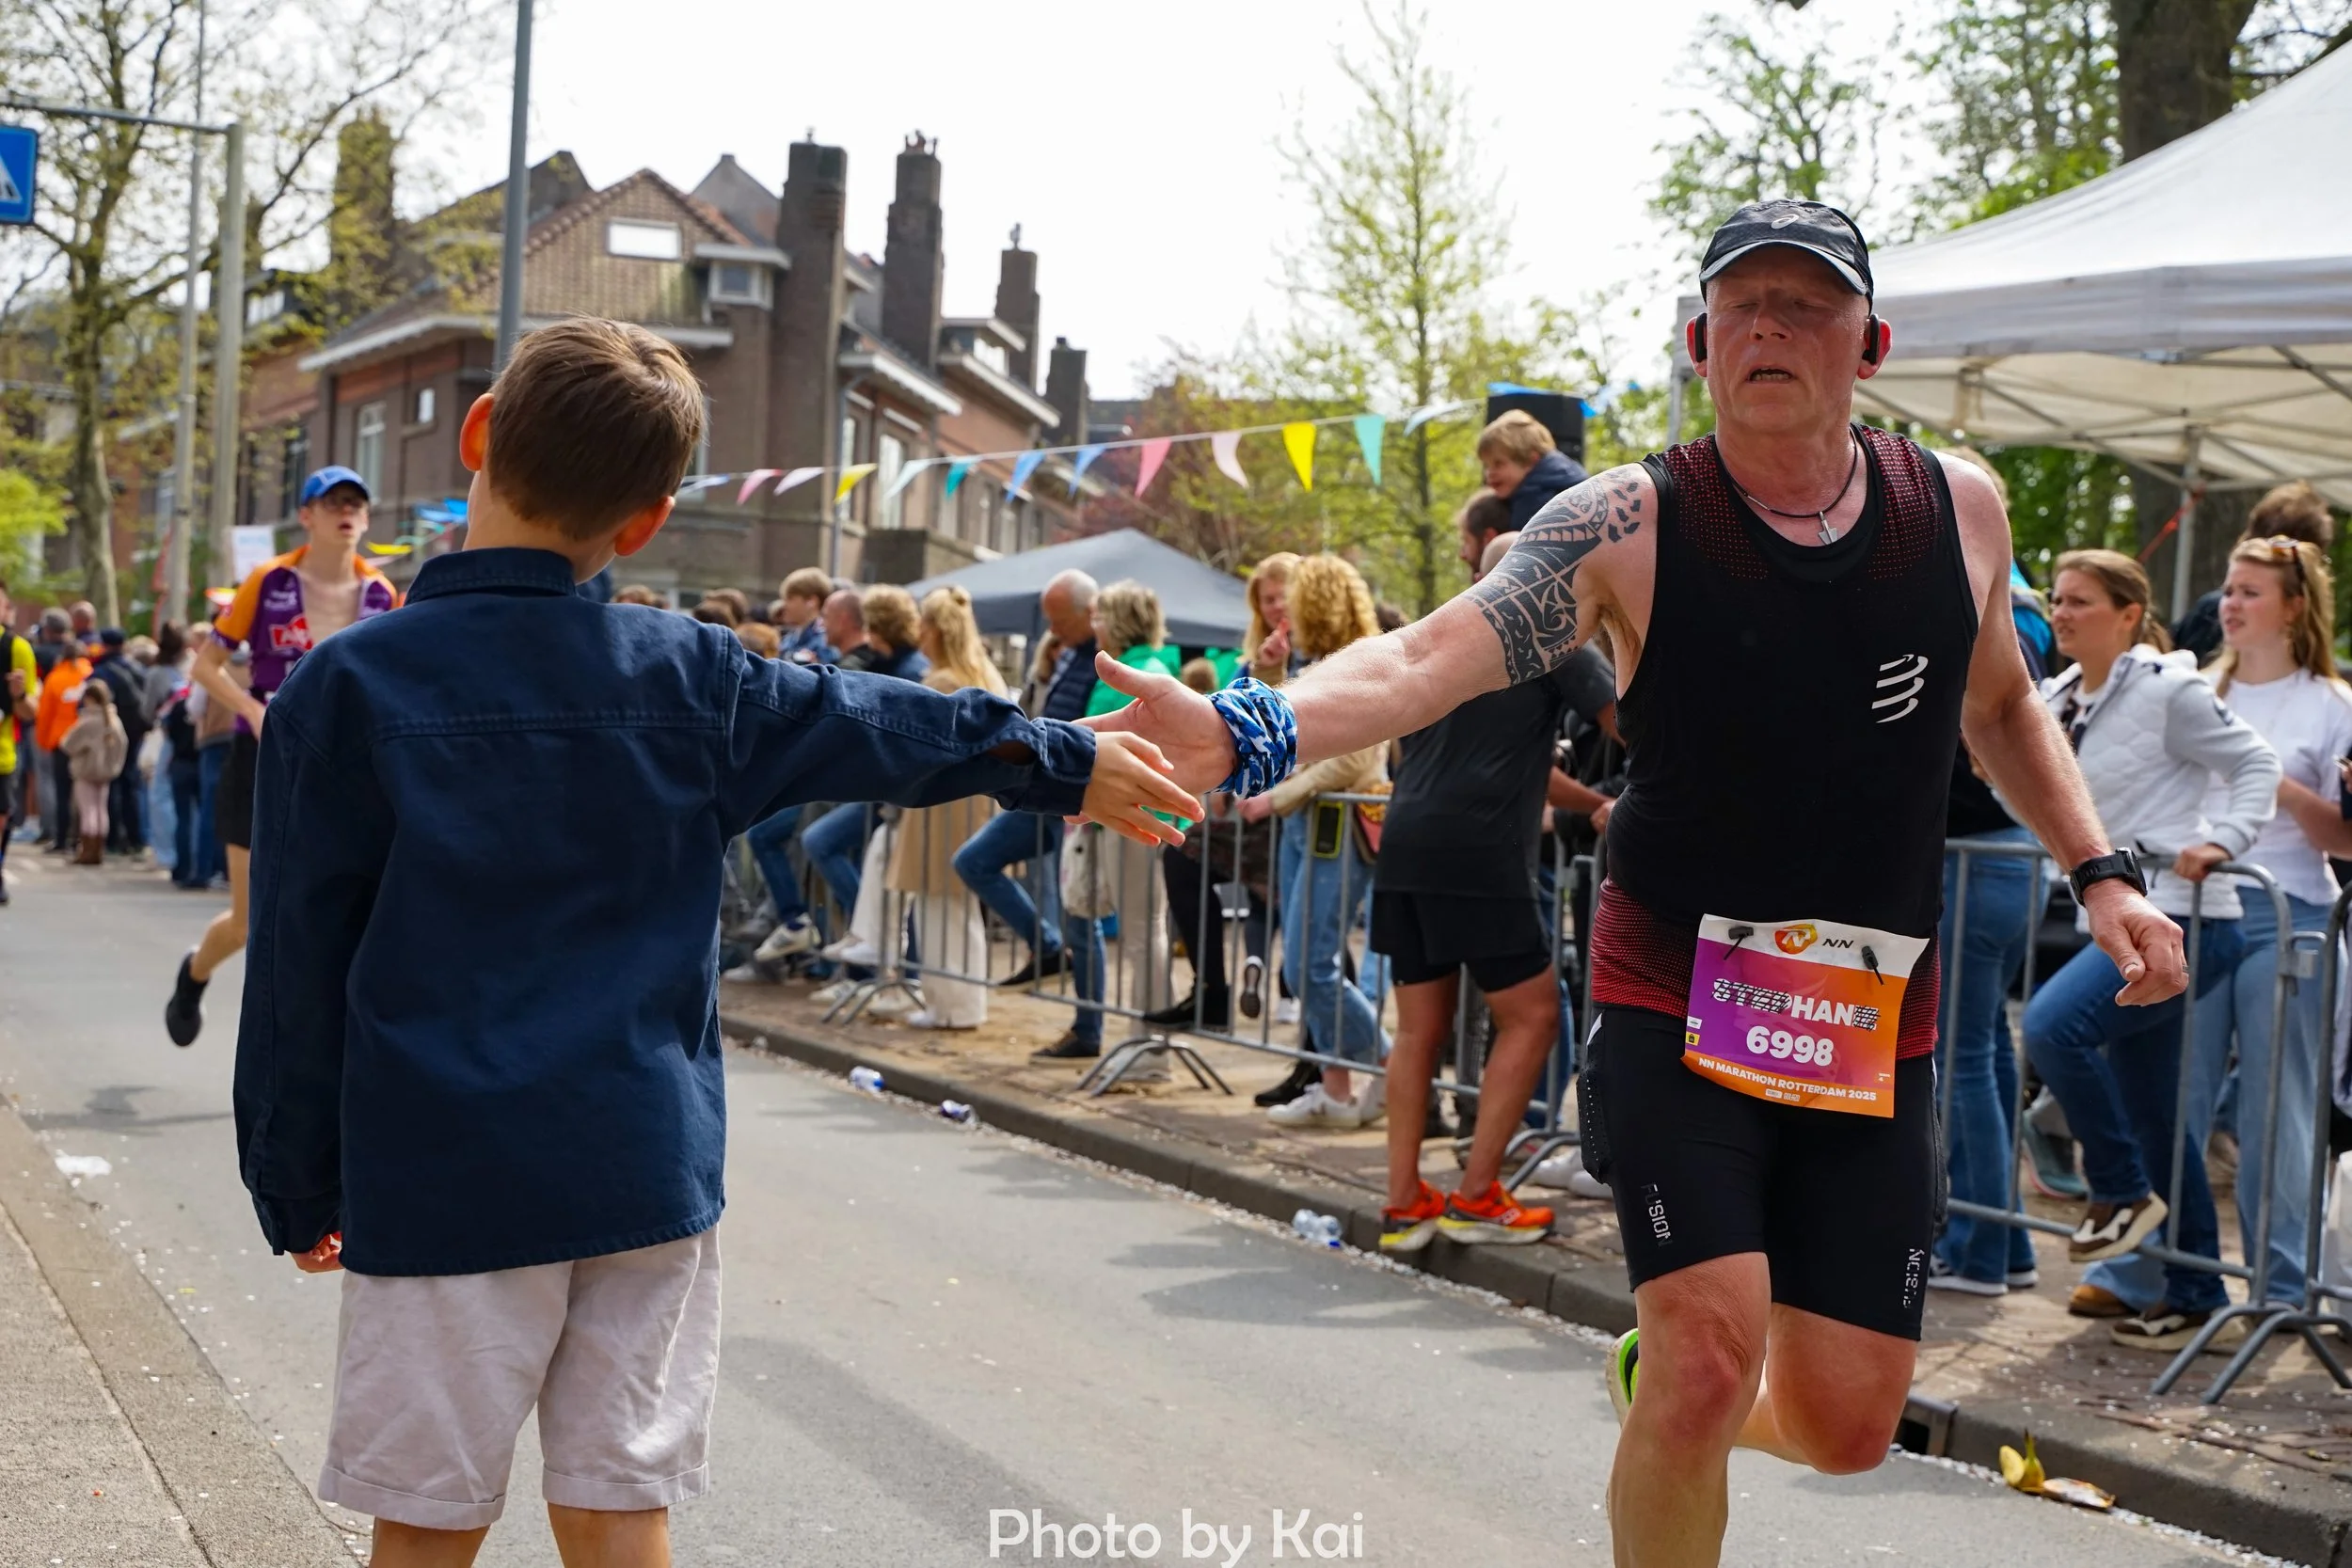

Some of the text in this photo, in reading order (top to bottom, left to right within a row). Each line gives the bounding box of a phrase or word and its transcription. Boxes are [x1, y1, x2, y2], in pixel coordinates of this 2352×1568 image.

[1822, 939, 1853, 948] NN
[1746, 1026, 1835, 1067] 6998
[1698, 1057, 1716, 1069] NN
[1716, 1061, 1776, 1086] MARATHON
[1778, 1080, 1846, 1098] ROTTERDAM
[1848, 1089, 1878, 1101] 2025
